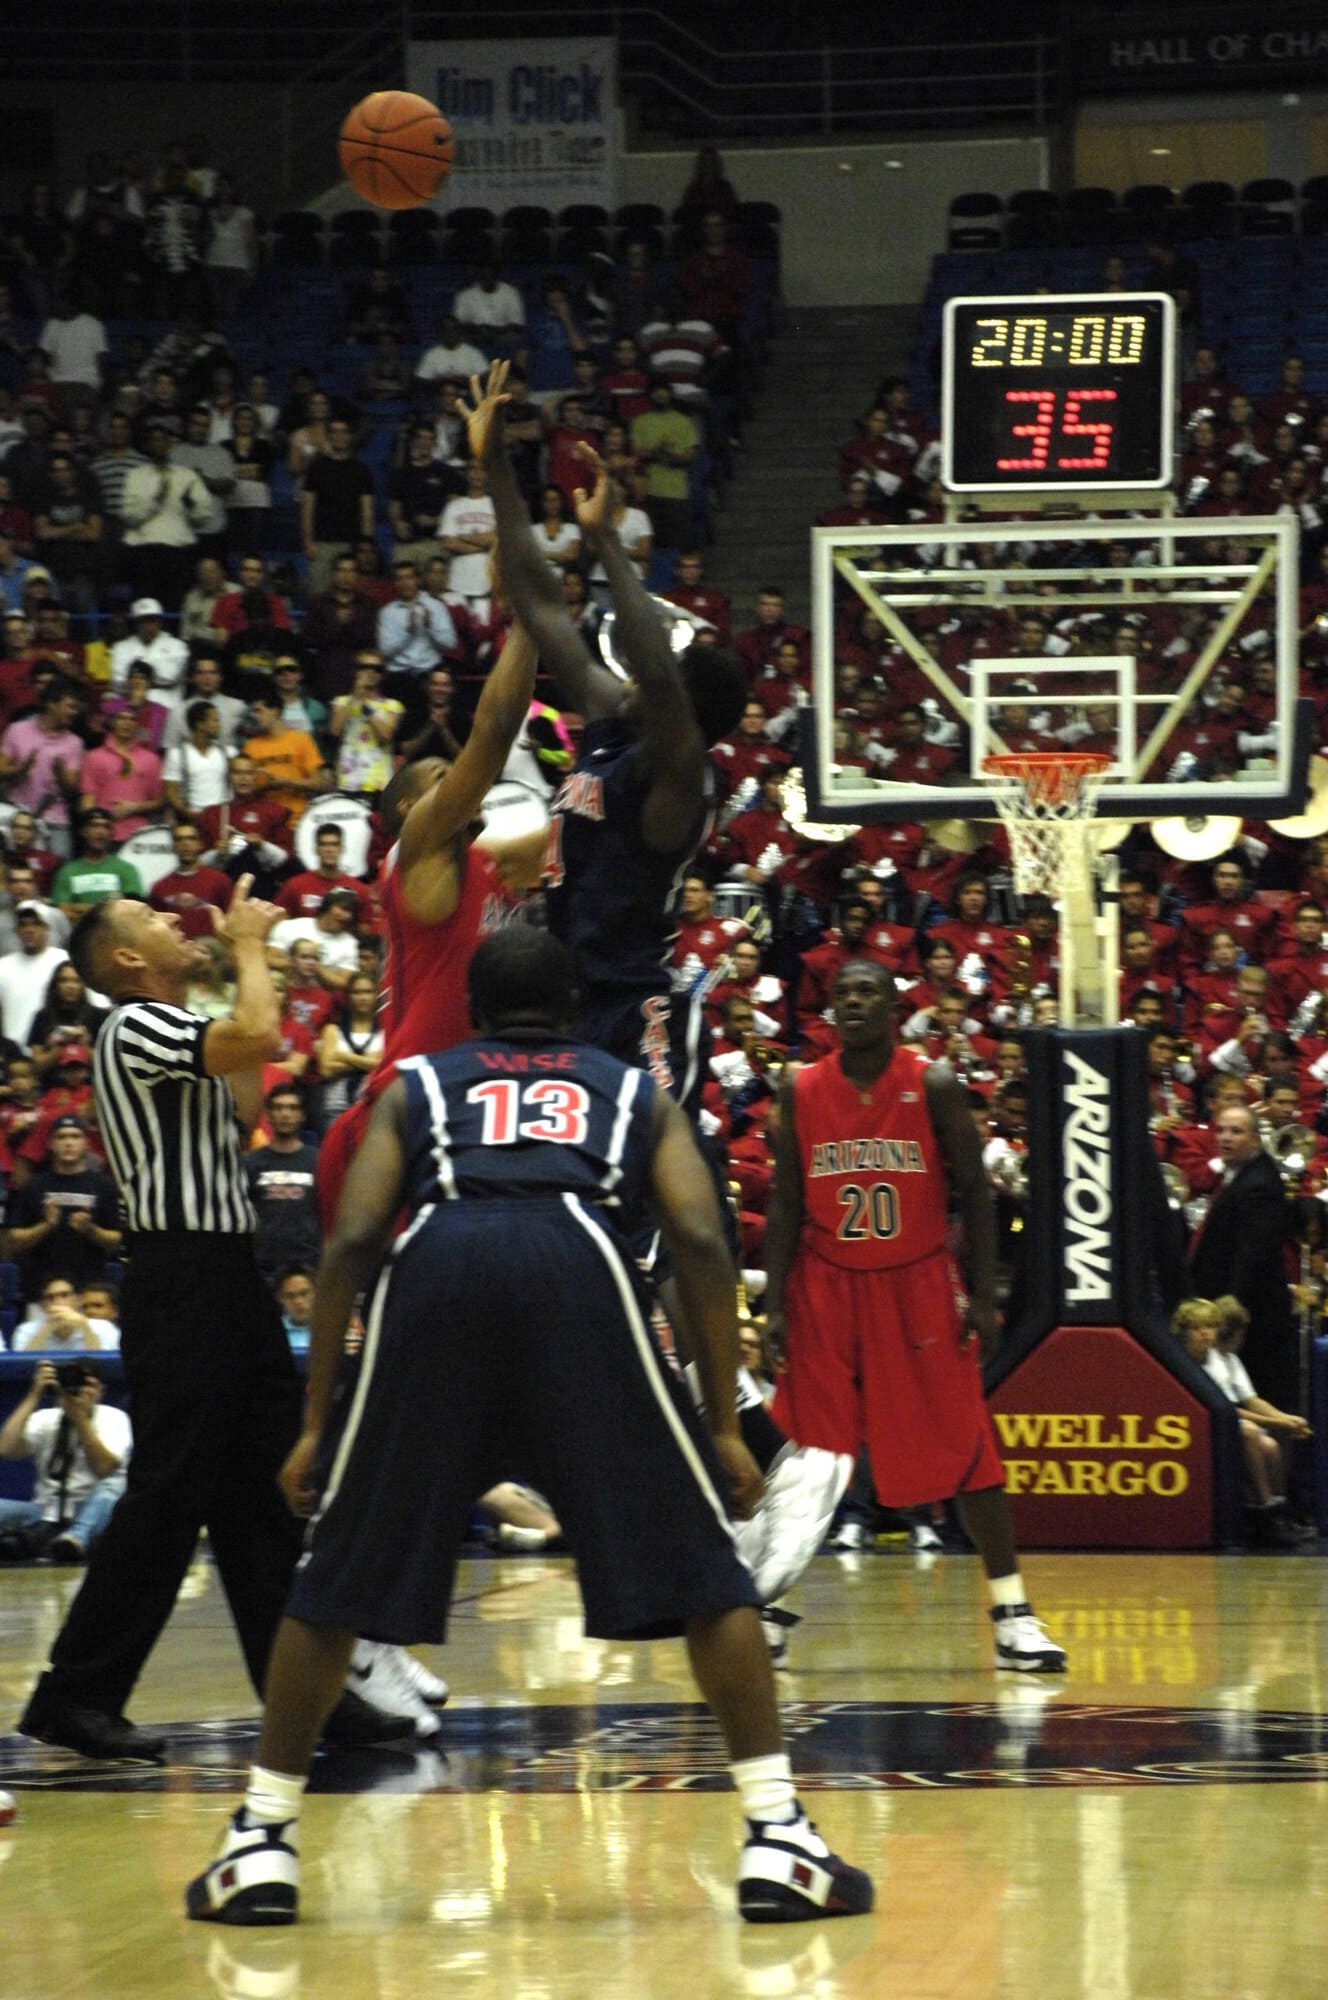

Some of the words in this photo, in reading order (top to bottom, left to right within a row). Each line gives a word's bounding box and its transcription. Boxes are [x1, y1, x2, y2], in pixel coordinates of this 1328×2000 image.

[1110, 38, 1196, 66] HALL
[1207, 34, 1250, 61] OF
[509, 63, 604, 125] Click
[971, 315, 1146, 367] 20:00
[996, 389, 1118, 470] 35
[475, 1051, 580, 1073] WISE
[466, 1079, 590, 1145] 13
[808, 1137, 928, 1178] ARIZONA
[1062, 1049, 1113, 1301] ARIZONA
[835, 1182, 902, 1241] 20
[992, 1413, 1192, 1450] WELLS
[1001, 1459, 1190, 1497] FARGO
